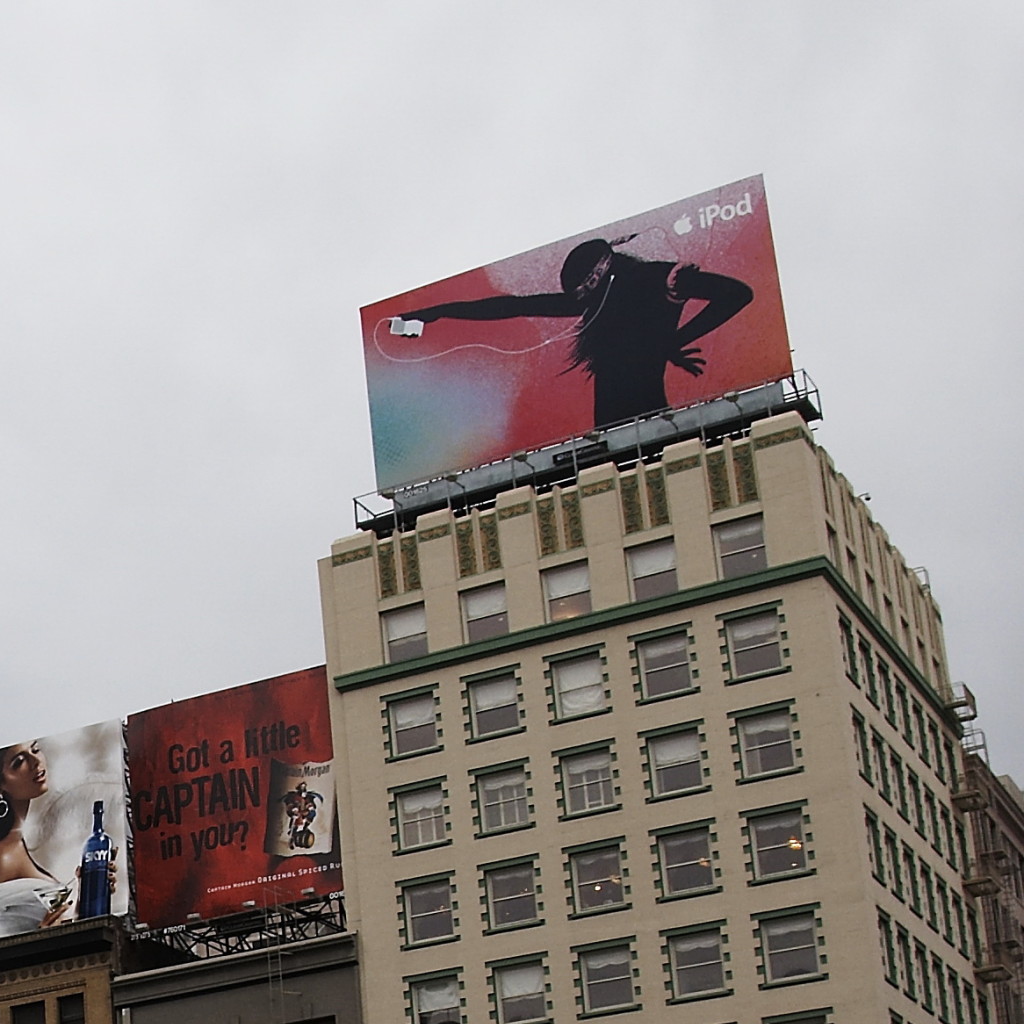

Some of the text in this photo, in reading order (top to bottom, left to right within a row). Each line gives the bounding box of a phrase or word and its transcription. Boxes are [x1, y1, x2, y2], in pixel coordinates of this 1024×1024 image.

[698, 193, 753, 229] iPod
[168, 721, 301, 774] Got a little
[133, 766, 261, 832] CAPTAIN
[84, 849, 108, 863] SKYY
[160, 821, 250, 862] in you?
[298, 864, 328, 876] SPICED
[329, 862, 341, 870] RU
